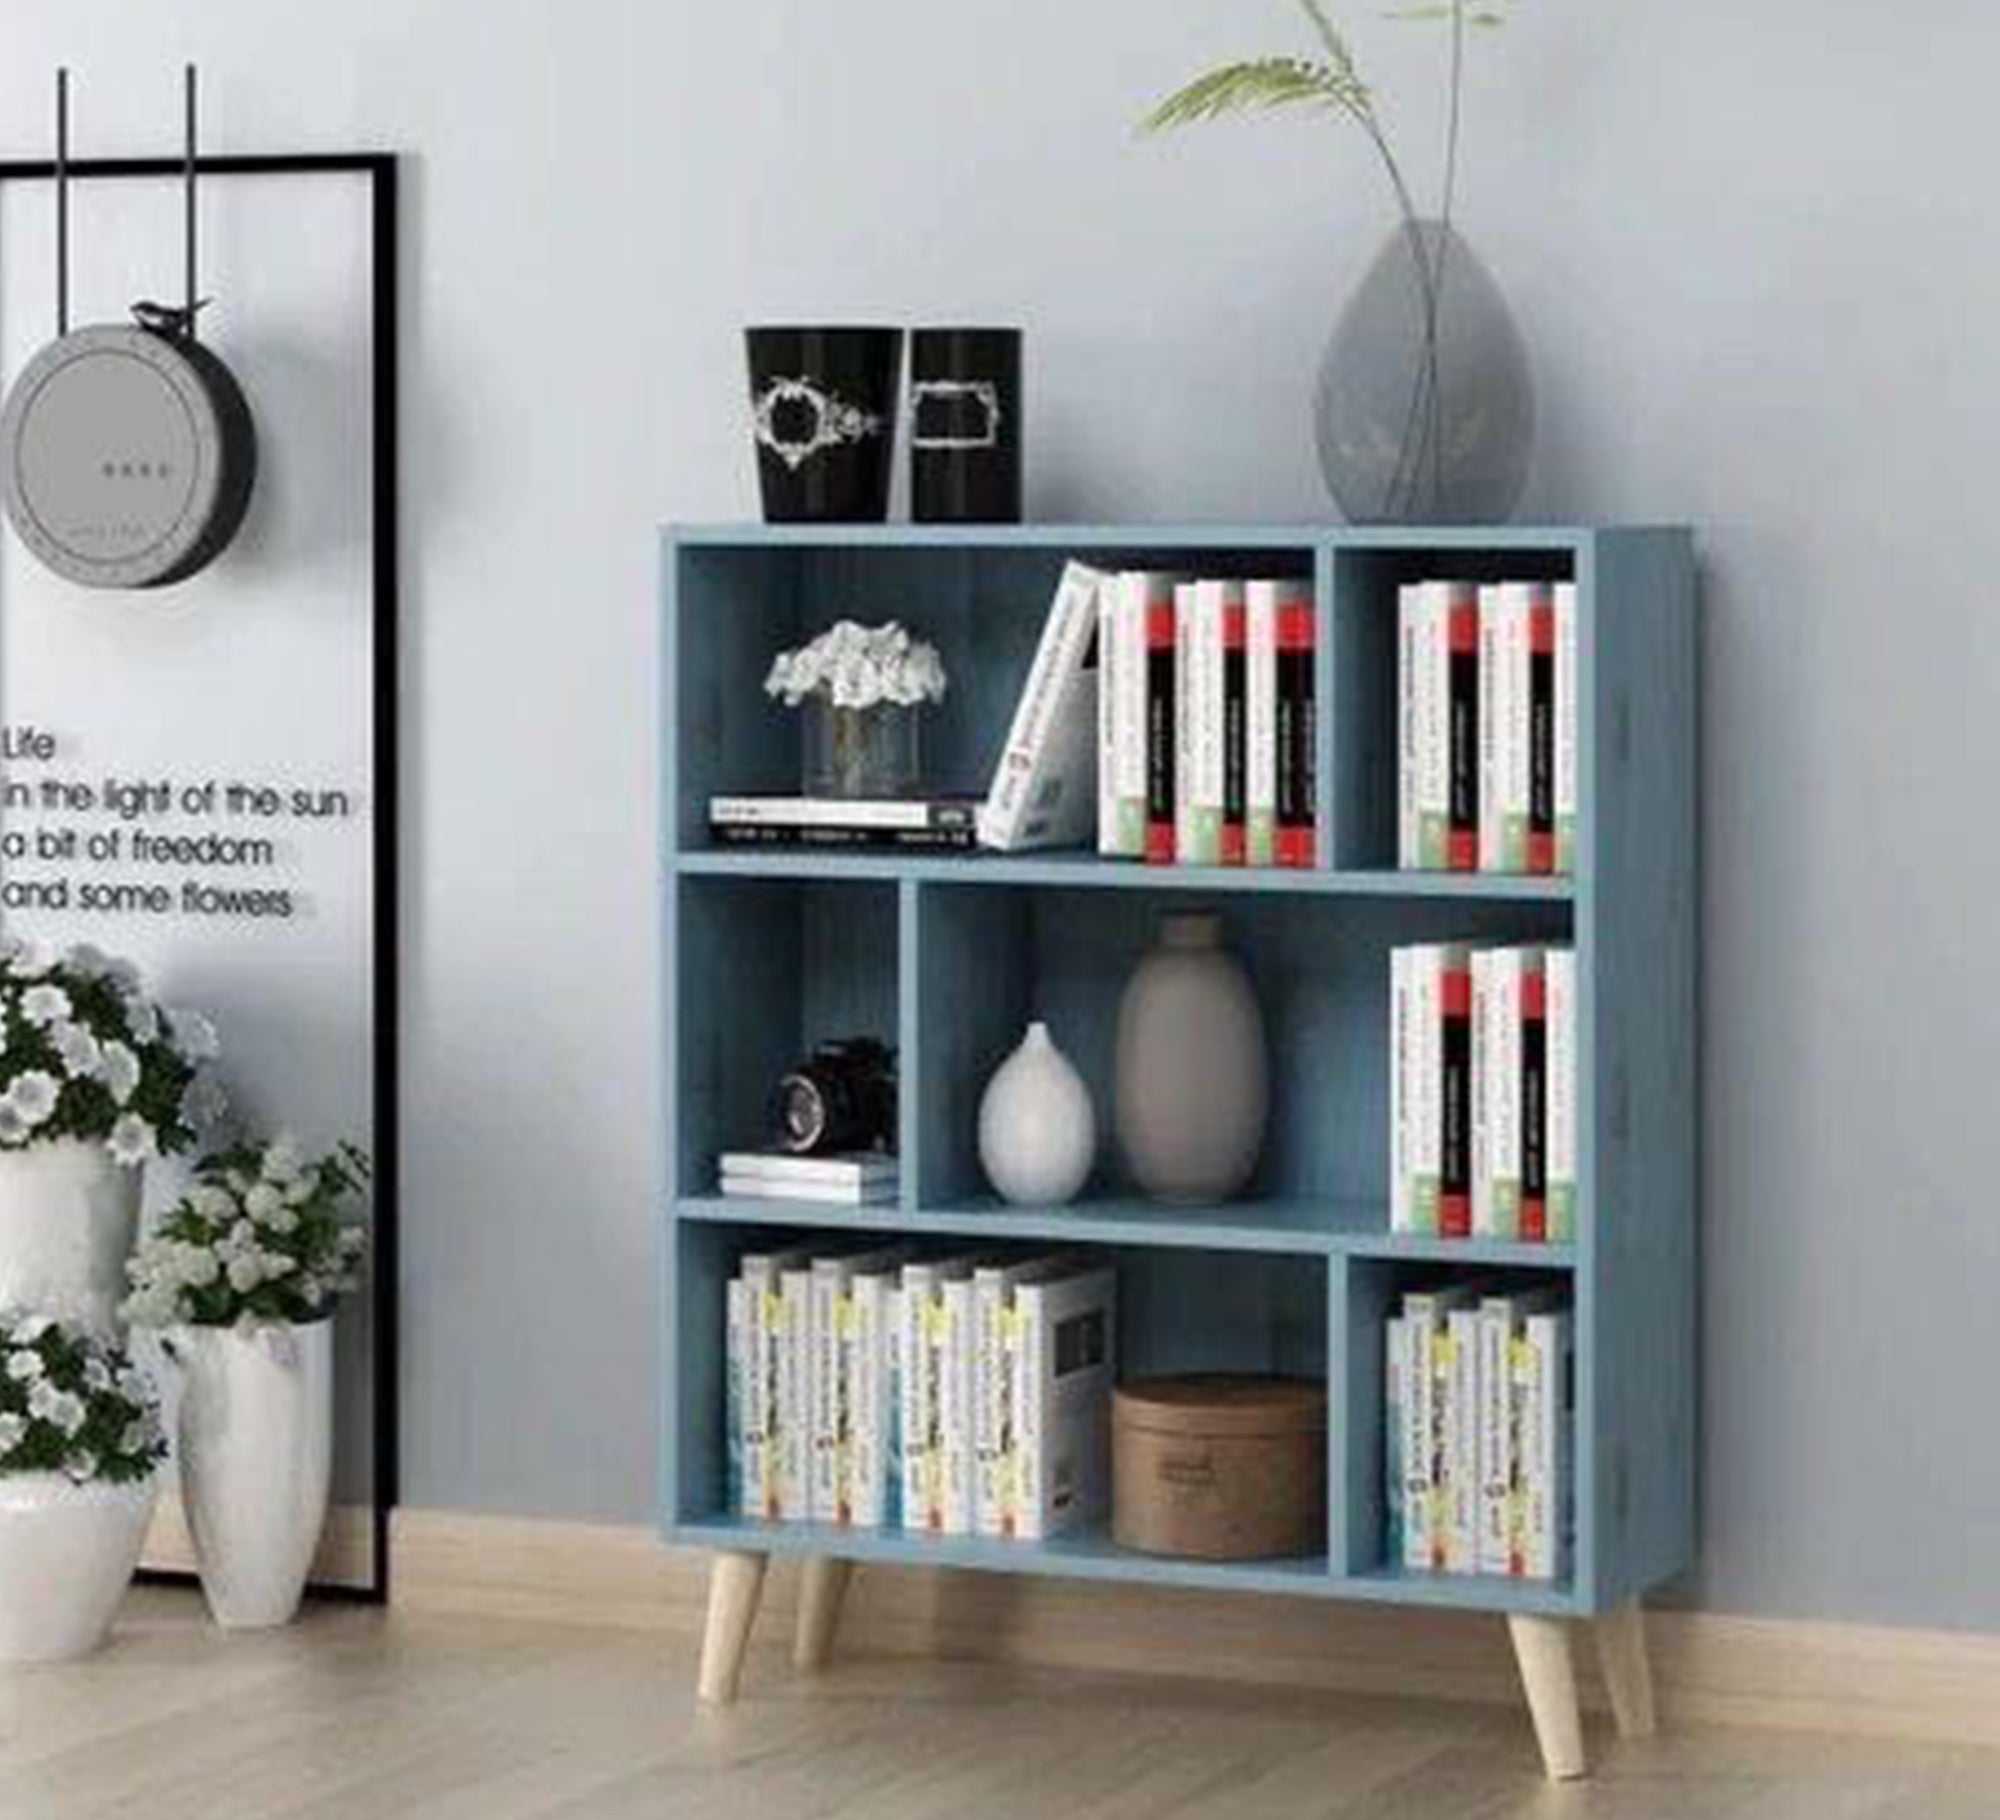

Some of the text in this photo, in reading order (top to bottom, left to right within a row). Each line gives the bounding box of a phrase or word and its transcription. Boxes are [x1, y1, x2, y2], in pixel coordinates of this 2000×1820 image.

[1, 726, 55, 760] Life
[40, 780, 94, 811] the
[103, 779, 170, 820] light
[181, 780, 215, 814] of
[226, 783, 281, 817] the
[291, 788, 348, 817] sun
[2, 826, 273, 865] a bit of freedom
[1, 878, 292, 917] and some flowers
